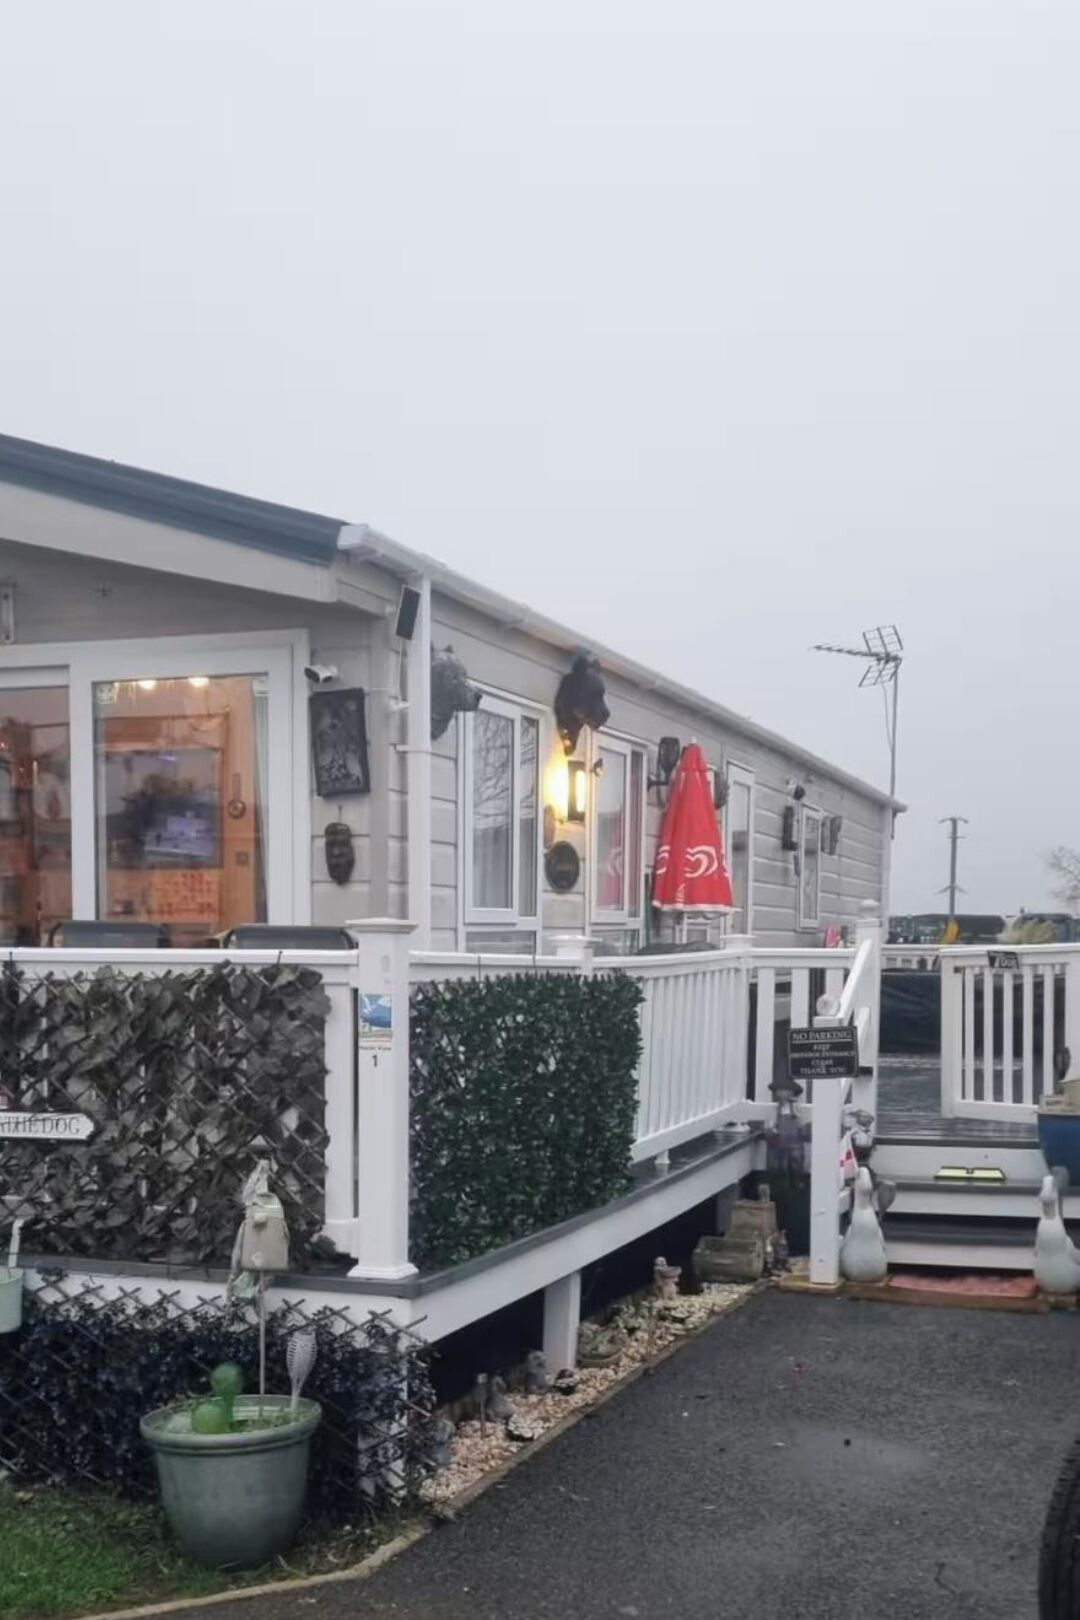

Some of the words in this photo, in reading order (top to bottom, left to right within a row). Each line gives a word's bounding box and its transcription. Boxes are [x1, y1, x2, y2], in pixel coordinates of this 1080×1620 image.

[792, 1032, 807, 1040] NO
[809, 1031, 851, 1040] PARKING
[372, 1054, 378, 1067] 1
